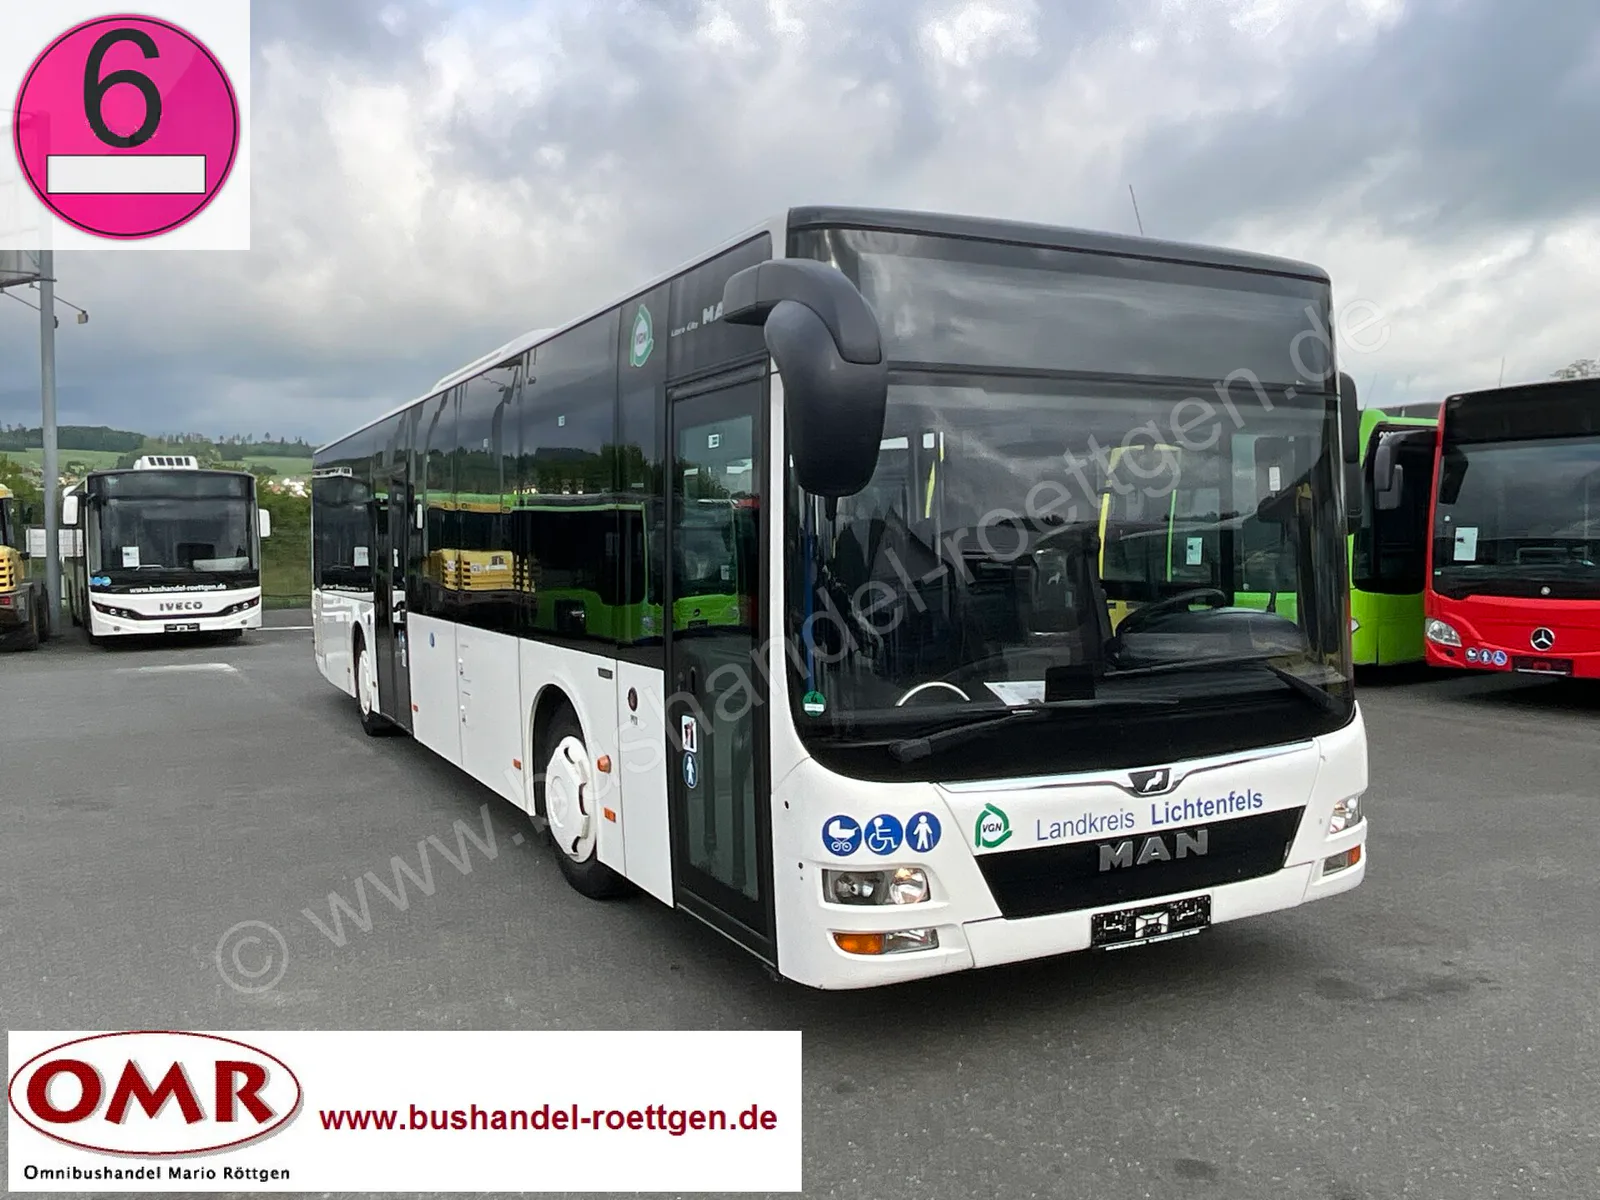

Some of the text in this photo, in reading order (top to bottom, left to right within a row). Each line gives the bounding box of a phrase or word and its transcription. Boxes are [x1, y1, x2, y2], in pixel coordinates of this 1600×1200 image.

[702, 301, 723, 325] MA
[129, 583, 227, 594] www.bushandel-roettgen.de
[159, 600, 203, 612] IVECO
[1036, 789, 1263, 841] Landkreis Lichtenfels
[982, 823, 1002, 834] VGN
[1098, 829, 1209, 871] MAN
